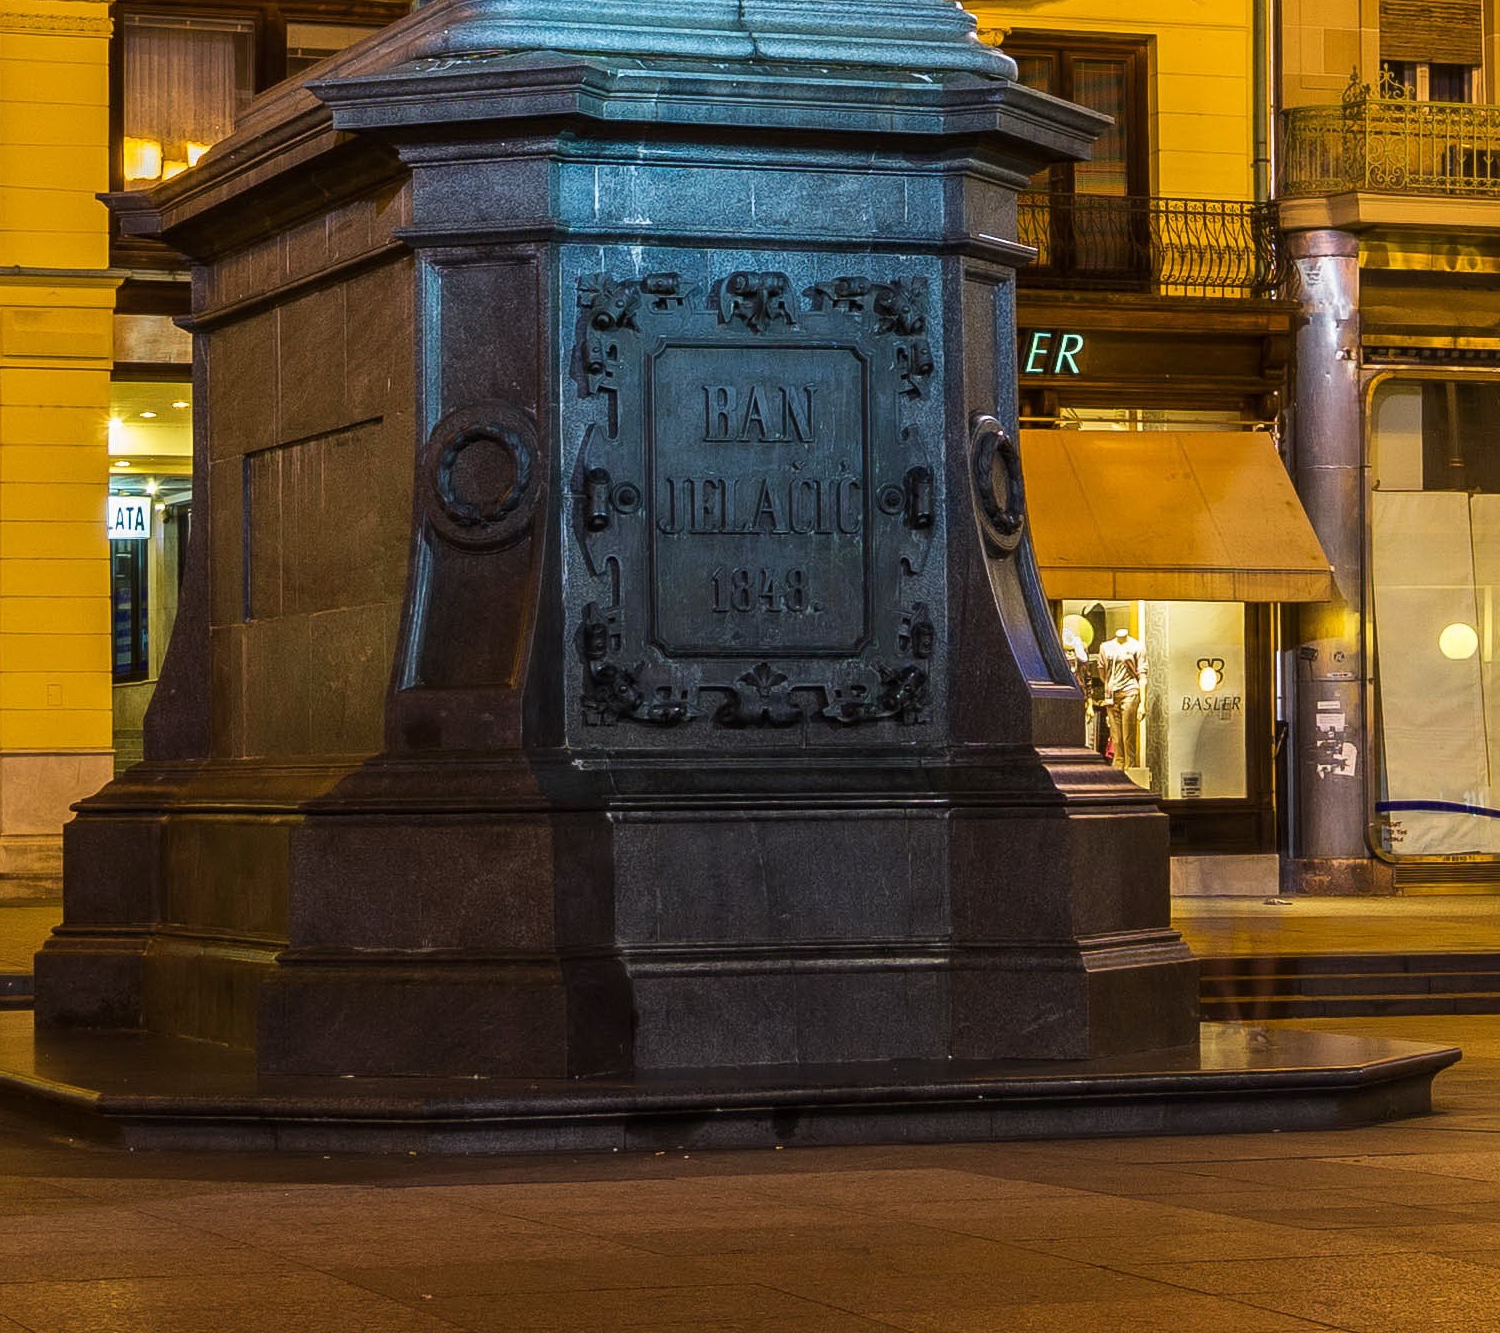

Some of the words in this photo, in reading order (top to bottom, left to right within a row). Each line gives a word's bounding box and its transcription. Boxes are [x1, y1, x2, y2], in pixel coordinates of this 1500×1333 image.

[701, 383, 818, 444] BAN
[108, 506, 145, 531] ATA
[656, 461, 862, 535] JELAČIĆ
[1181, 695, 1242, 711] BASLER
